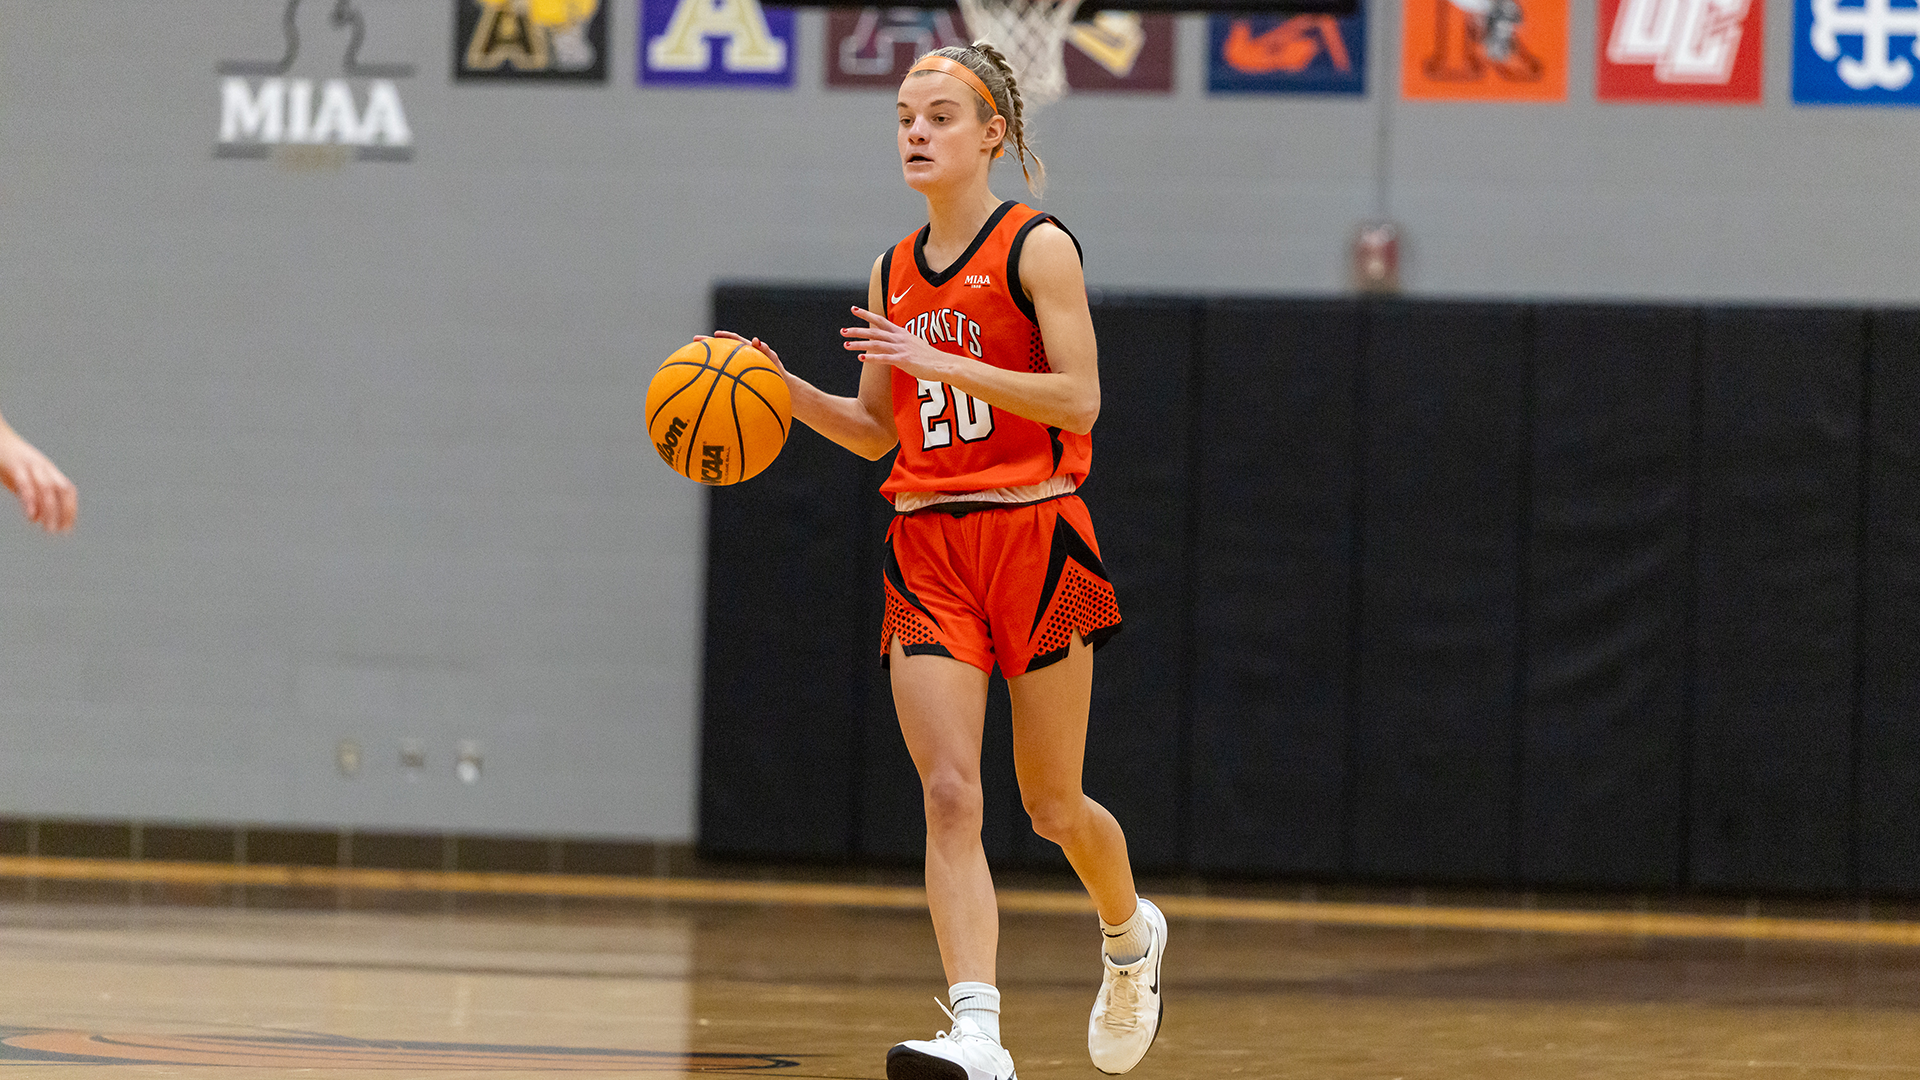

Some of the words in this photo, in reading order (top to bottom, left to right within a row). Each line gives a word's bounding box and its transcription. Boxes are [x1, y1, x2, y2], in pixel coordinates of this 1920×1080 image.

[646, 0, 788, 73] A
[218, 77, 415, 146] MIAA
[964, 275, 991, 284] MIAA
[904, 308, 983, 358] ORNETS
[916, 378, 995, 451] 20
[701, 445, 724, 484] NCAA
